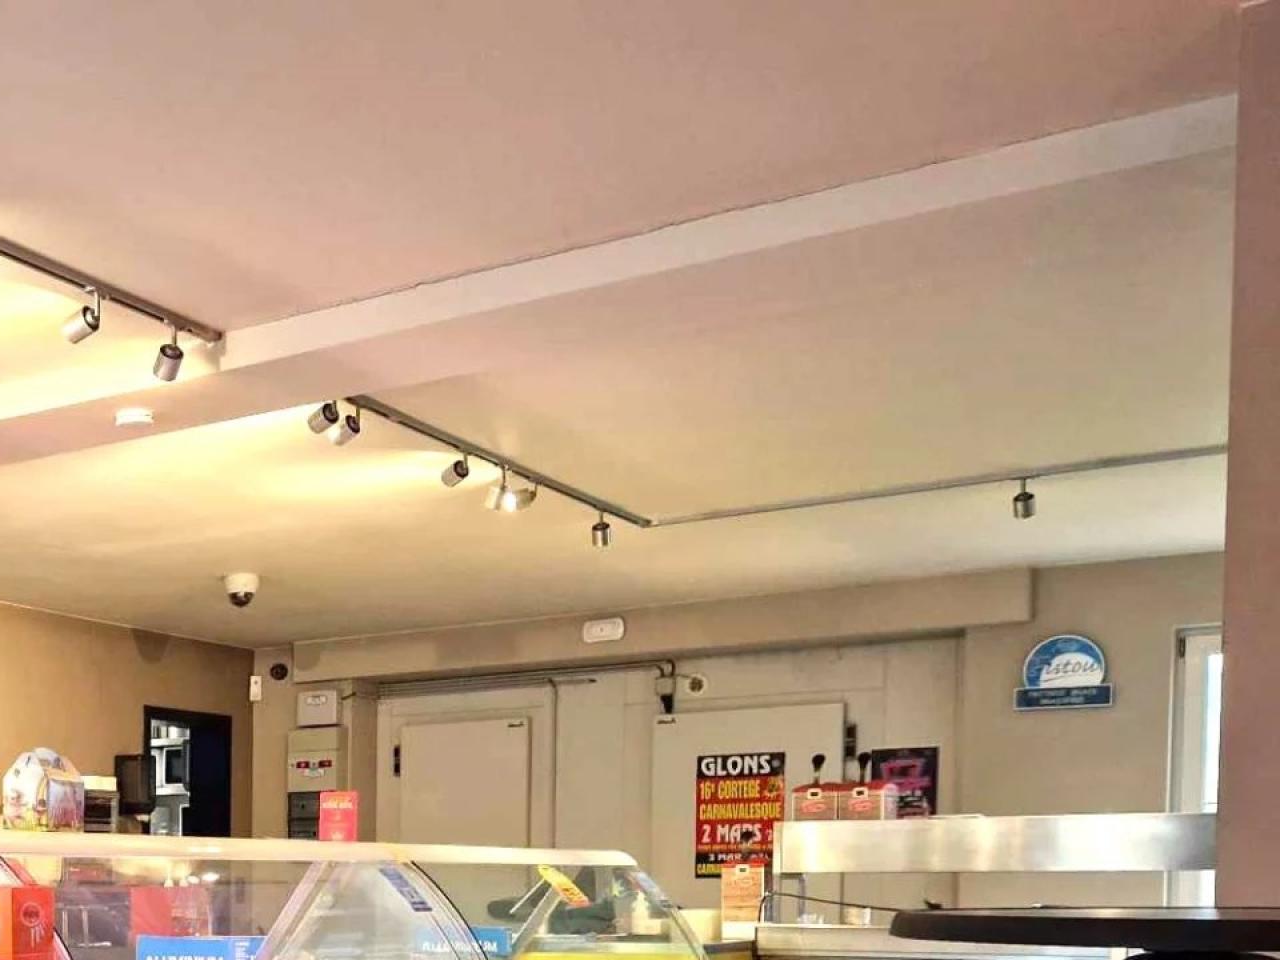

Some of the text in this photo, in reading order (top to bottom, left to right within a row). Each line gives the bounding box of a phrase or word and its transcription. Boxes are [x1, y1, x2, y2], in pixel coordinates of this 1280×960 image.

[700, 754, 772, 777] GLONS
[699, 801, 783, 821] CARNAVALESQUE
[701, 823, 712, 843] 2
